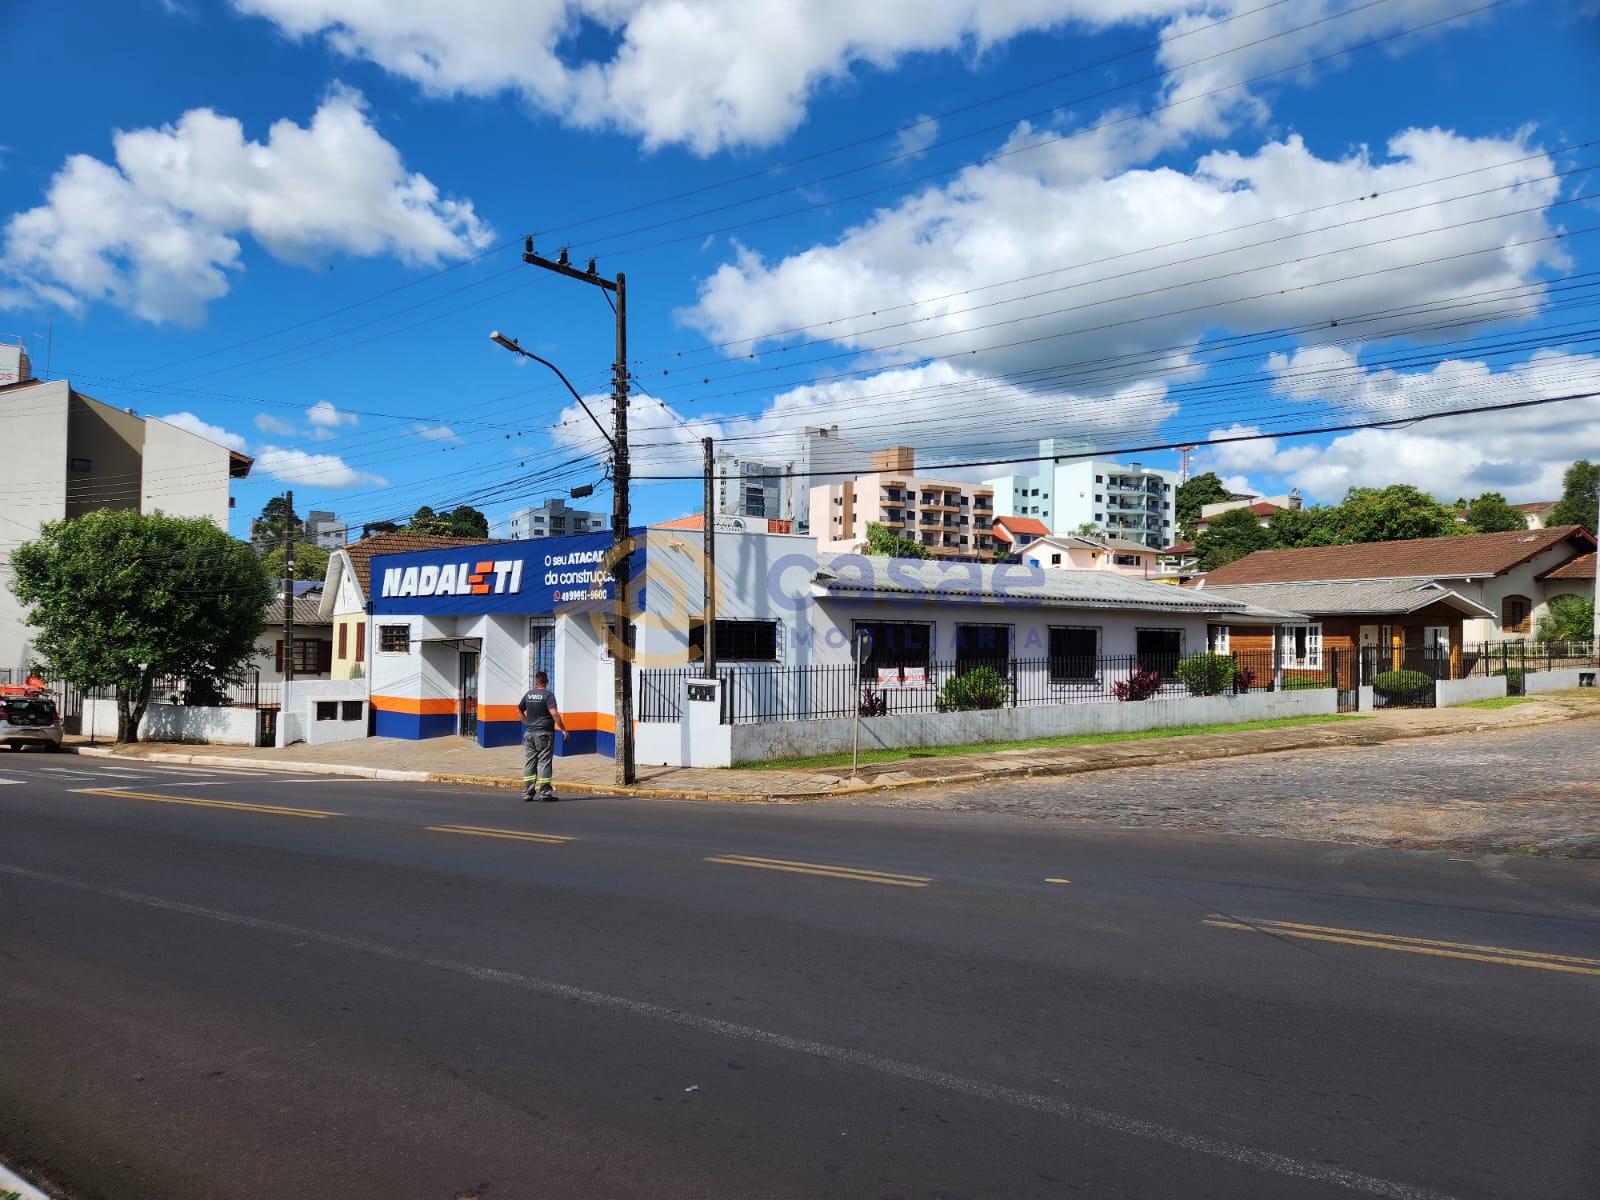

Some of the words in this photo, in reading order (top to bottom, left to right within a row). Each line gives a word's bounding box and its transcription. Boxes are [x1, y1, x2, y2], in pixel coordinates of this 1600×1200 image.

[544, 555, 551, 567] O
[552, 555, 566, 566] seu
[381, 559, 523, 598] NADALETI
[544, 570, 558, 585] da
